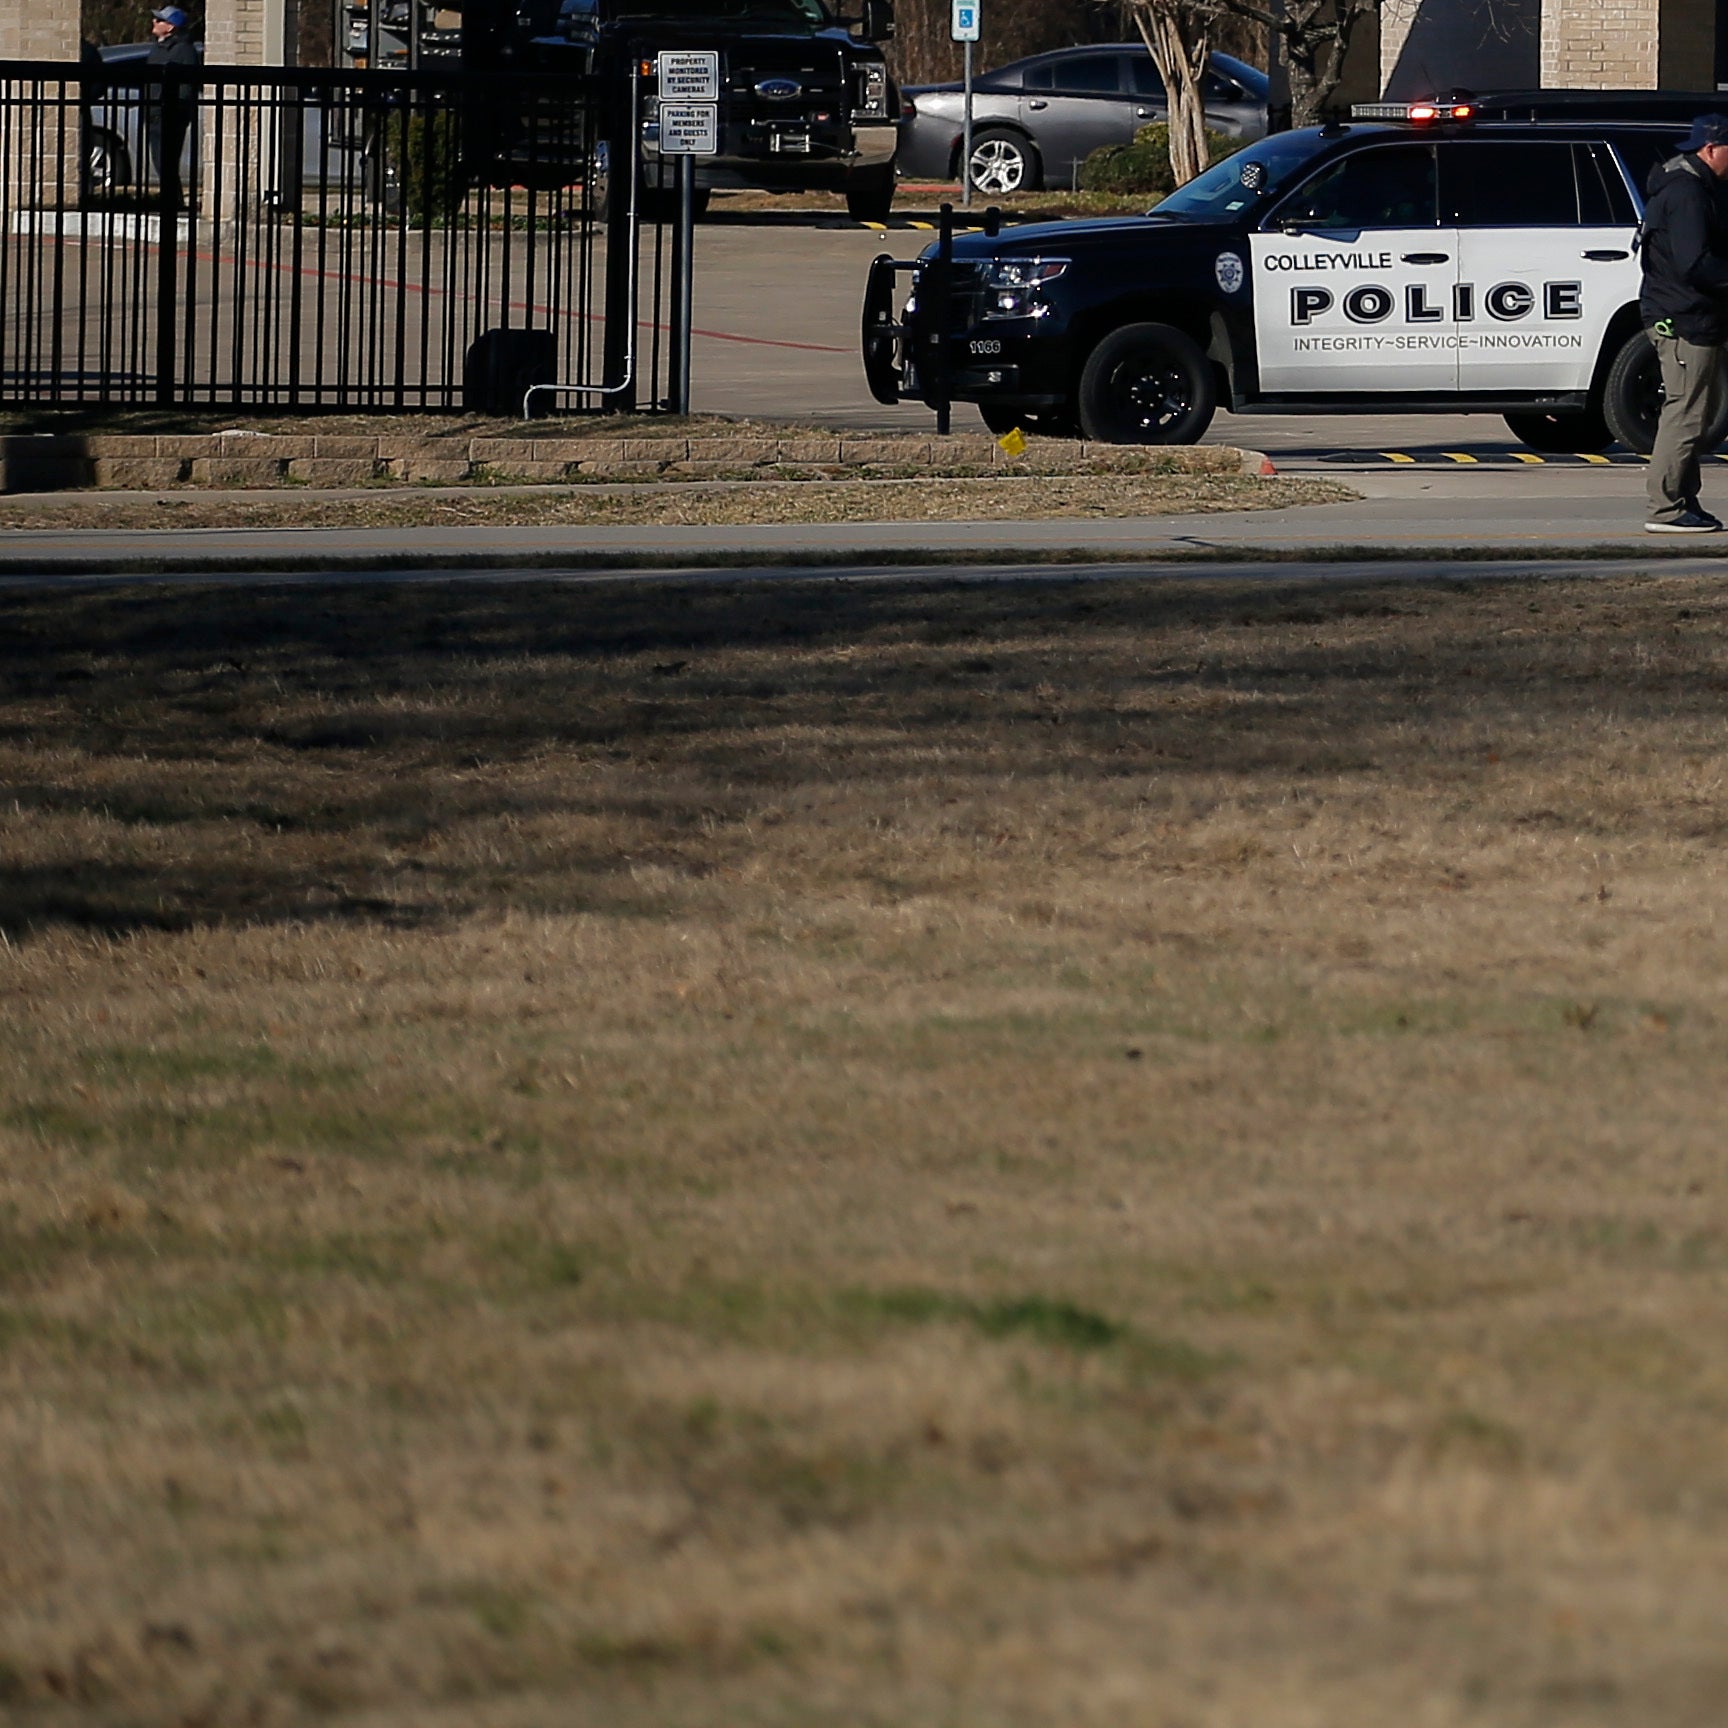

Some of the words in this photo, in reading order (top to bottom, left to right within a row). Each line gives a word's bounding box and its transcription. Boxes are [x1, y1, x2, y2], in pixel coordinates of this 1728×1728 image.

[1264, 252, 1392, 271] COLLEYVILLE
[1290, 280, 1583, 326] POLICE
[969, 340, 1001, 353] 1166
